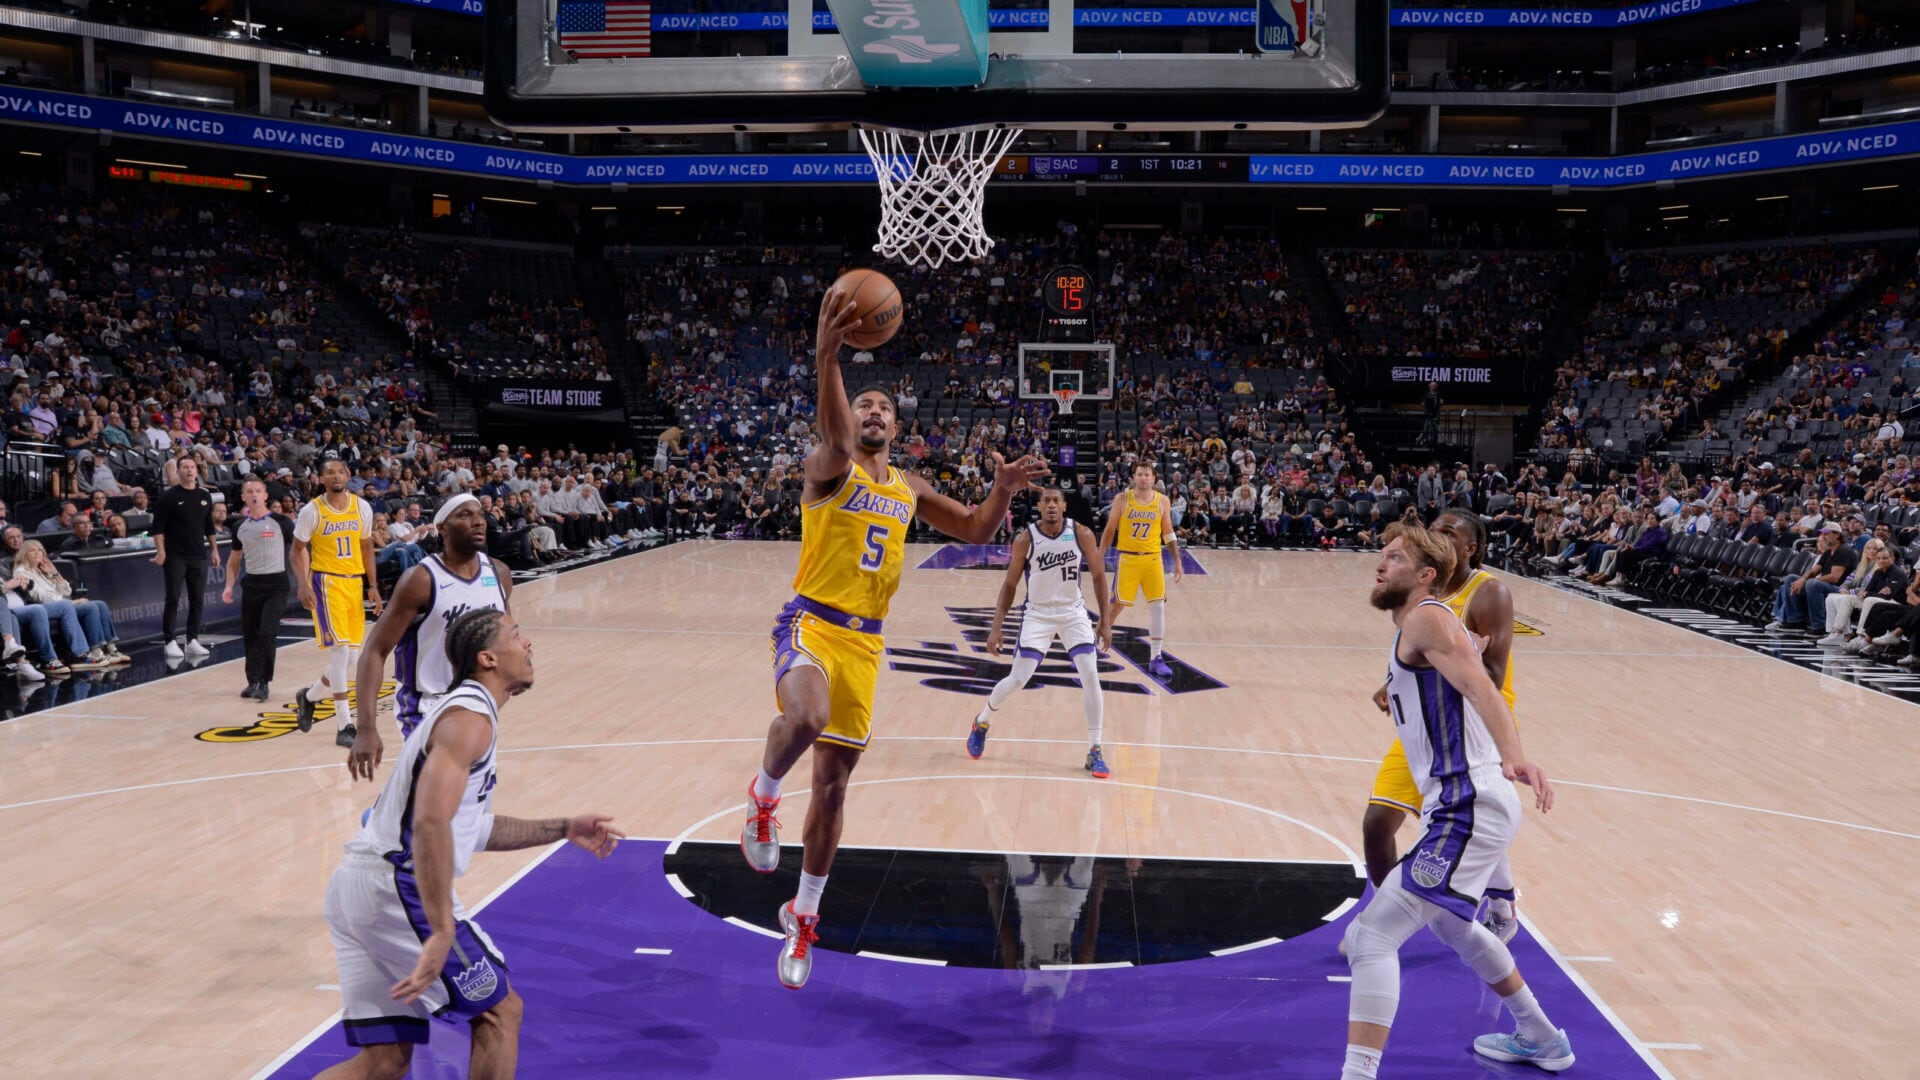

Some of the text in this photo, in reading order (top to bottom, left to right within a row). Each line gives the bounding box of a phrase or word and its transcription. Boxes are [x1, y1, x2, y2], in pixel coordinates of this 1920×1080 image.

[1080, 11, 1162, 23] ADVANCED
[1186, 11, 1257, 23] ADVANCE
[1400, 11, 1485, 24] ADVANCED
[1508, 12, 1593, 24] ADVANCED
[1617, 0, 1701, 22] ADVANCED
[660, 15, 739, 28] ADVANCED
[1263, 26, 1289, 45] NBA
[123, 111, 225, 135] ADVANCED
[252, 127, 345, 149] ADVANCED
[1796, 134, 1898, 158] ADVANCED
[370, 141, 455, 162] ADVANCED
[485, 155, 564, 175] ADVANCED
[688, 164, 769, 175] ADVANCED
[792, 163, 874, 175] ADVANCED
[1008, 159, 1016, 170] 2
[1053, 159, 1078, 170] SAC
[1110, 159, 1119, 170] 2
[1140, 159, 1160, 170] 1ST
[1170, 159, 1202, 170] 10:21
[1251, 163, 1314, 176] VANCED
[1670, 151, 1760, 172] ADVANCED
[586, 165, 666, 177] ADVANCED
[1339, 164, 1425, 177] ADVANCED
[1450, 165, 1535, 178] ADVANCED
[1559, 164, 1646, 180] ADVANCED
[1056, 276, 1085, 289] 10:20
[1063, 289, 1082, 310] 15
[1059, 318, 1088, 326] TISSOT
[1391, 367, 1491, 383] Kings TEAM STORE
[502, 389, 602, 406] Kings TEAM STORE
[839, 484, 912, 525] LAKERS
[1127, 508, 1157, 521] LAKERS
[322, 519, 360, 536] LAKERS
[1131, 522, 1152, 539] 77
[336, 536, 353, 559] 11
[859, 522, 889, 572] 5
[1036, 549, 1077, 571] Kings
[1061, 566, 1077, 582] 15
[1414, 861, 1444, 880] KINGS
[462, 971, 495, 995] KINGS
